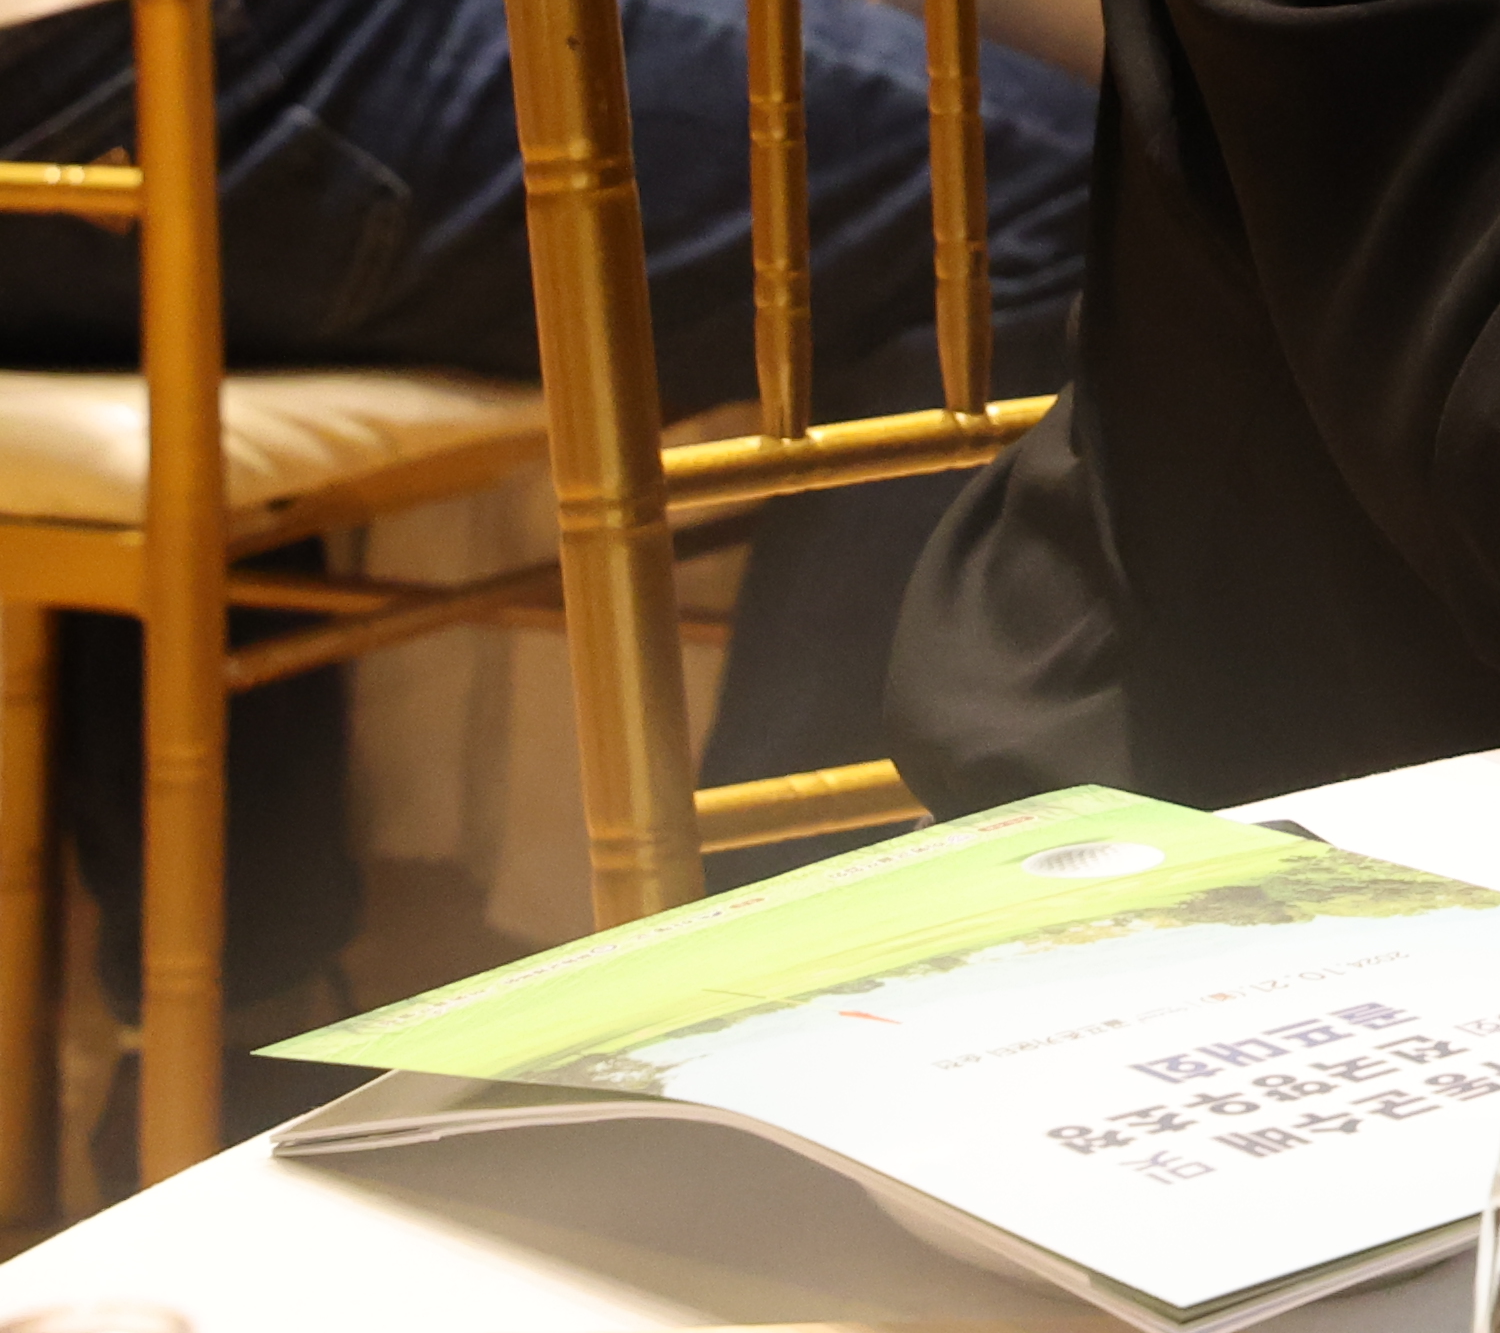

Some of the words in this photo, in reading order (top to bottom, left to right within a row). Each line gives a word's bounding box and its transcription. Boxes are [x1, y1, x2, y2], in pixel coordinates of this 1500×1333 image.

[1126, 1001, 1422, 1084] 골프대회
[1045, 1034, 1473, 1156] 전국향우초청
[1117, 1149, 1218, 1185] 및
